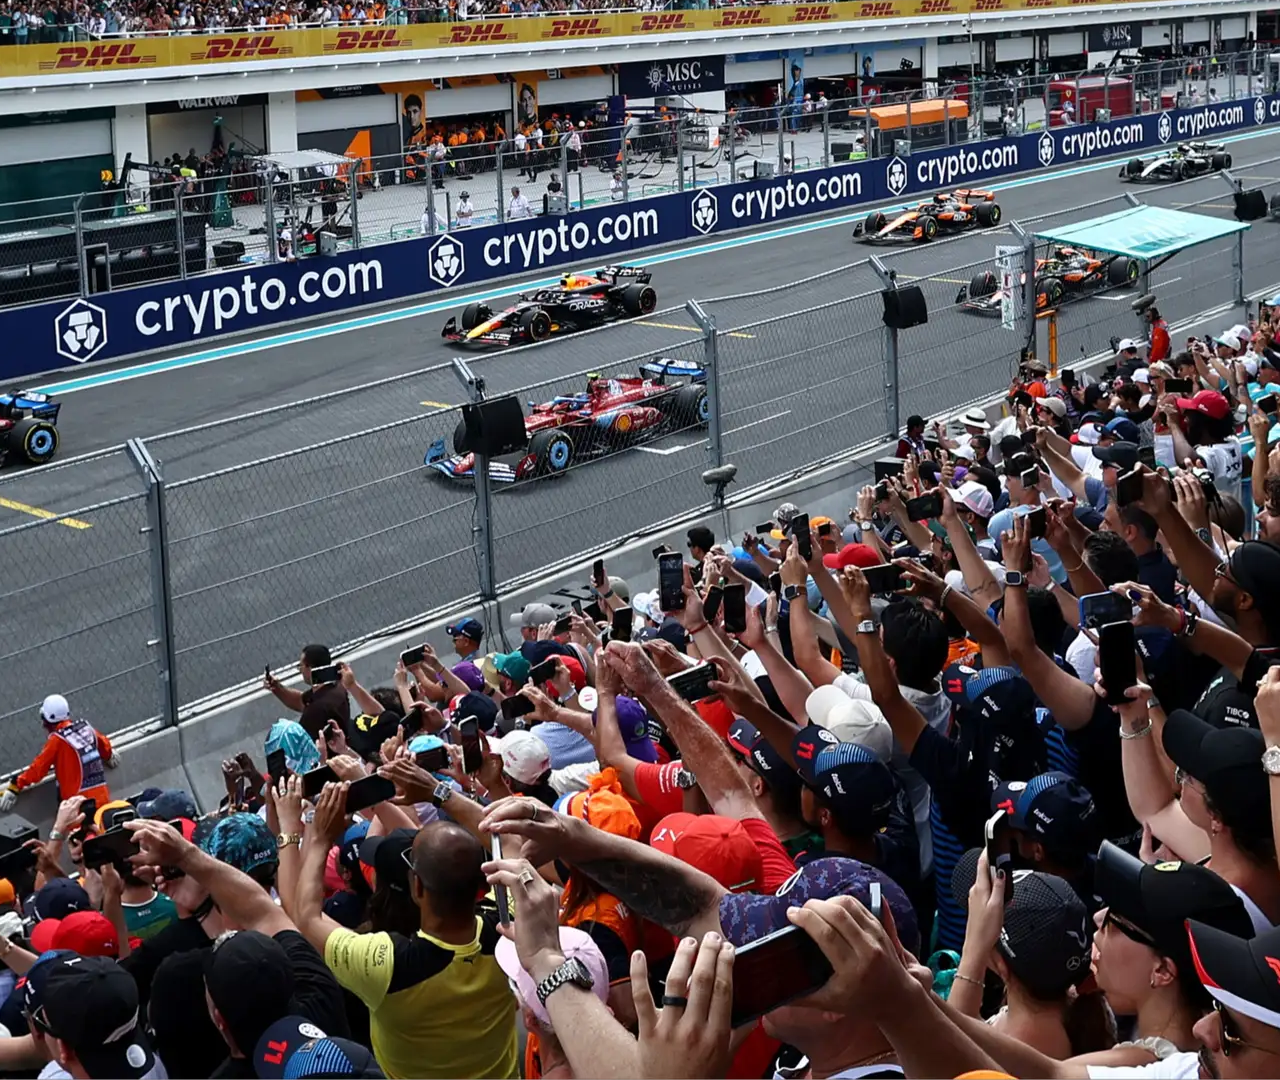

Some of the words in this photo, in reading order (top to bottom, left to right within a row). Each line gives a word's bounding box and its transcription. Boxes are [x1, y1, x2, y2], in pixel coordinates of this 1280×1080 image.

[795, 6, 831, 22] DHL
[861, 2, 894, 17] DHL
[920, 0, 951, 13] DHL
[550, 18, 601, 37] DHL
[643, 13, 687, 30] DHL
[722, 9, 763, 26] DHL
[335, 29, 401, 51] DHL
[450, 23, 508, 43] DHL
[1112, 25, 1131, 40] MSC
[56, 43, 141, 69] DHL
[205, 36, 280, 59] DHL
[666, 61, 701, 82] MSC
[668, 83, 702, 93] RUISES
[178, 96, 213, 109] WALK
[219, 95, 239, 106] WAY
[1177, 104, 1243, 136] crypto.com
[1062, 122, 1143, 156] crypto.com
[917, 144, 1018, 184] crypto.com
[731, 172, 862, 220] crypto.com
[483, 208, 658, 268] crypto.com
[135, 259, 383, 336] crypto.com
[569, 299, 604, 311] ORACLE
[754, 750, 772, 771] telcel
[1033, 808, 1054, 824] telcel
[254, 849, 271, 860] BOSS
[377, 944, 388, 966] aws
